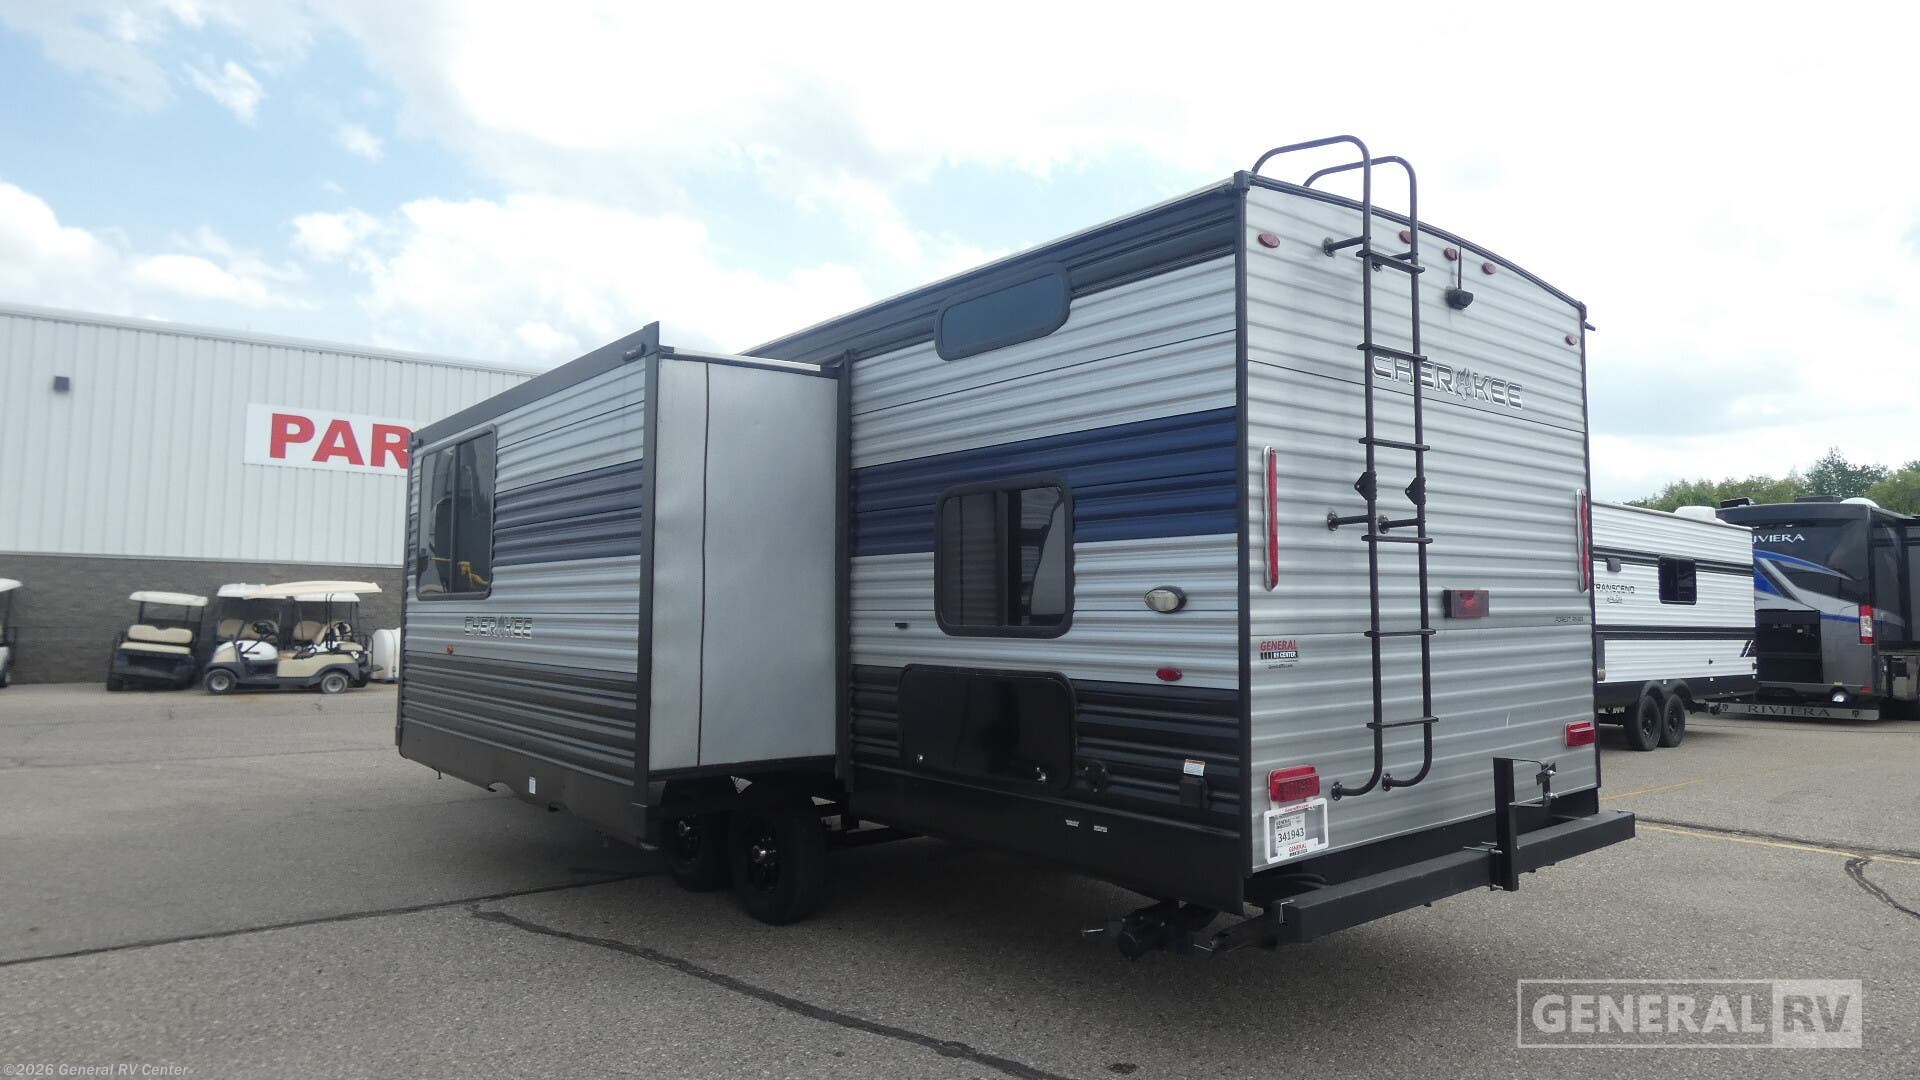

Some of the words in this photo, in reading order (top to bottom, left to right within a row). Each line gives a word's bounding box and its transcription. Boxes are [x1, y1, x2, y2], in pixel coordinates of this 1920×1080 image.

[1753, 533, 1805, 544] IVIERA
[1594, 583, 1635, 594] RANSCEND
[1260, 640, 1297, 651] GENERAL
[1748, 703, 1831, 718] RIVIERA
[1277, 827, 1305, 843] 341943
